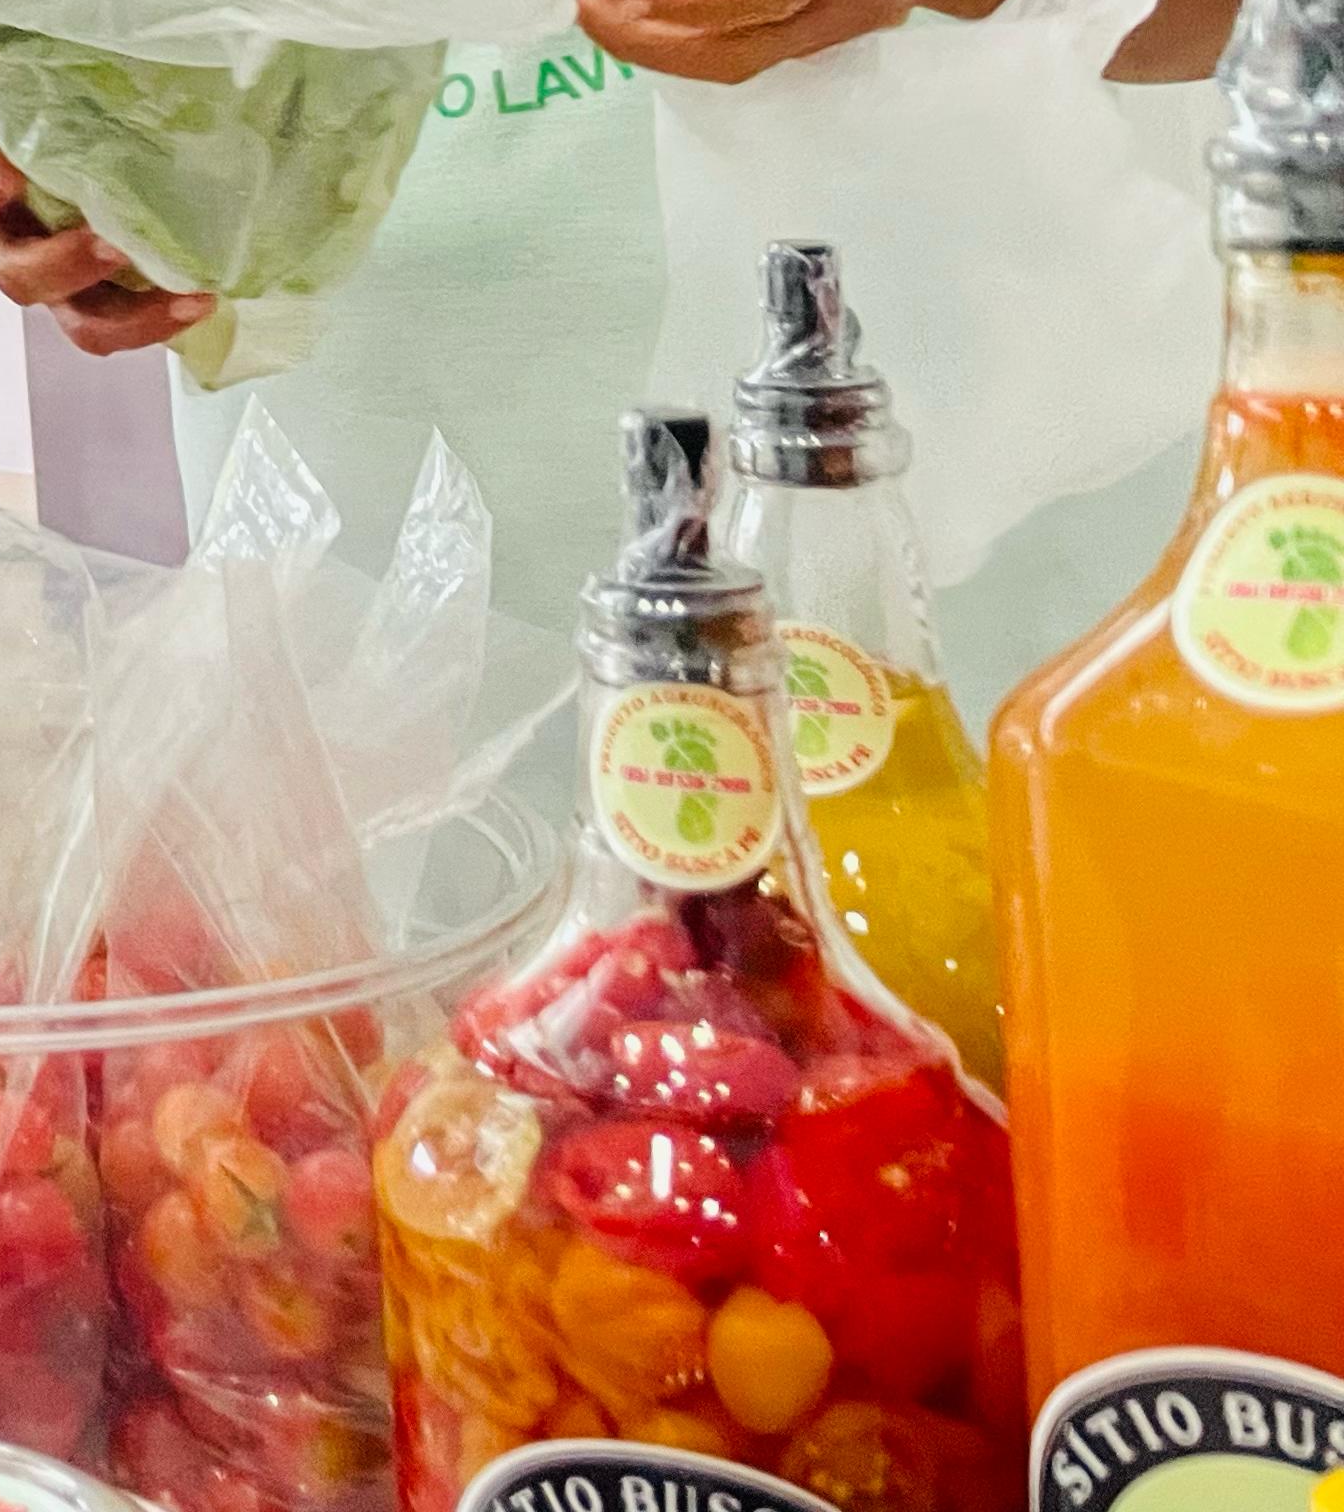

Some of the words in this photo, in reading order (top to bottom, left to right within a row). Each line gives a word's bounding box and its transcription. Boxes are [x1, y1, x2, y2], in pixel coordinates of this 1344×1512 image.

[433, 72, 476, 118] O
[492, 45, 634, 114] LAV
[1051, 1390, 1204, 1507] SÍTIO
